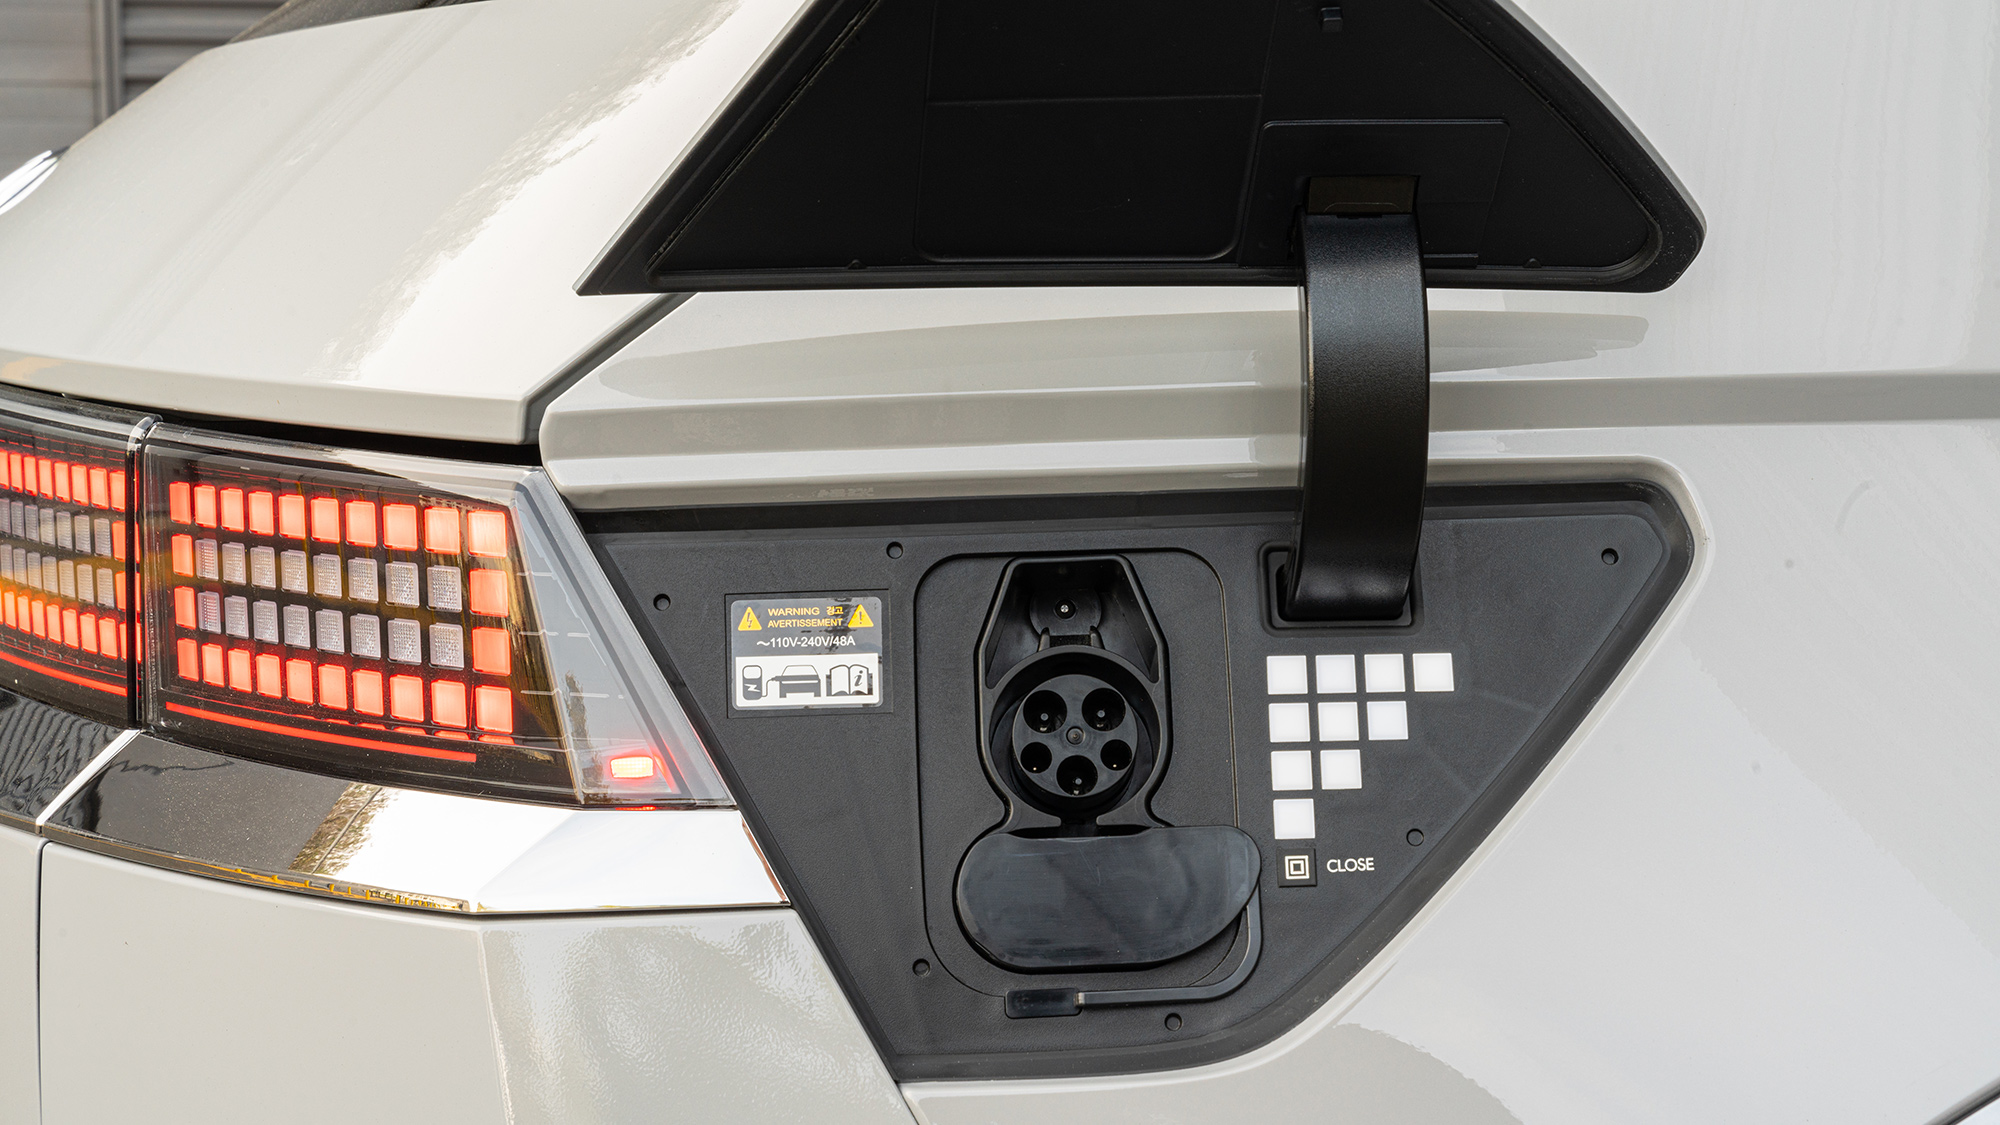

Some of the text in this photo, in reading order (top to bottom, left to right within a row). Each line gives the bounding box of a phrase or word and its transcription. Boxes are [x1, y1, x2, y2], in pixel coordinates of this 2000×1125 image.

[768, 607, 820, 616] WARNING
[768, 618, 843, 628] AVERTISSEMENT
[1326, 857, 1375, 873] CLOSE
